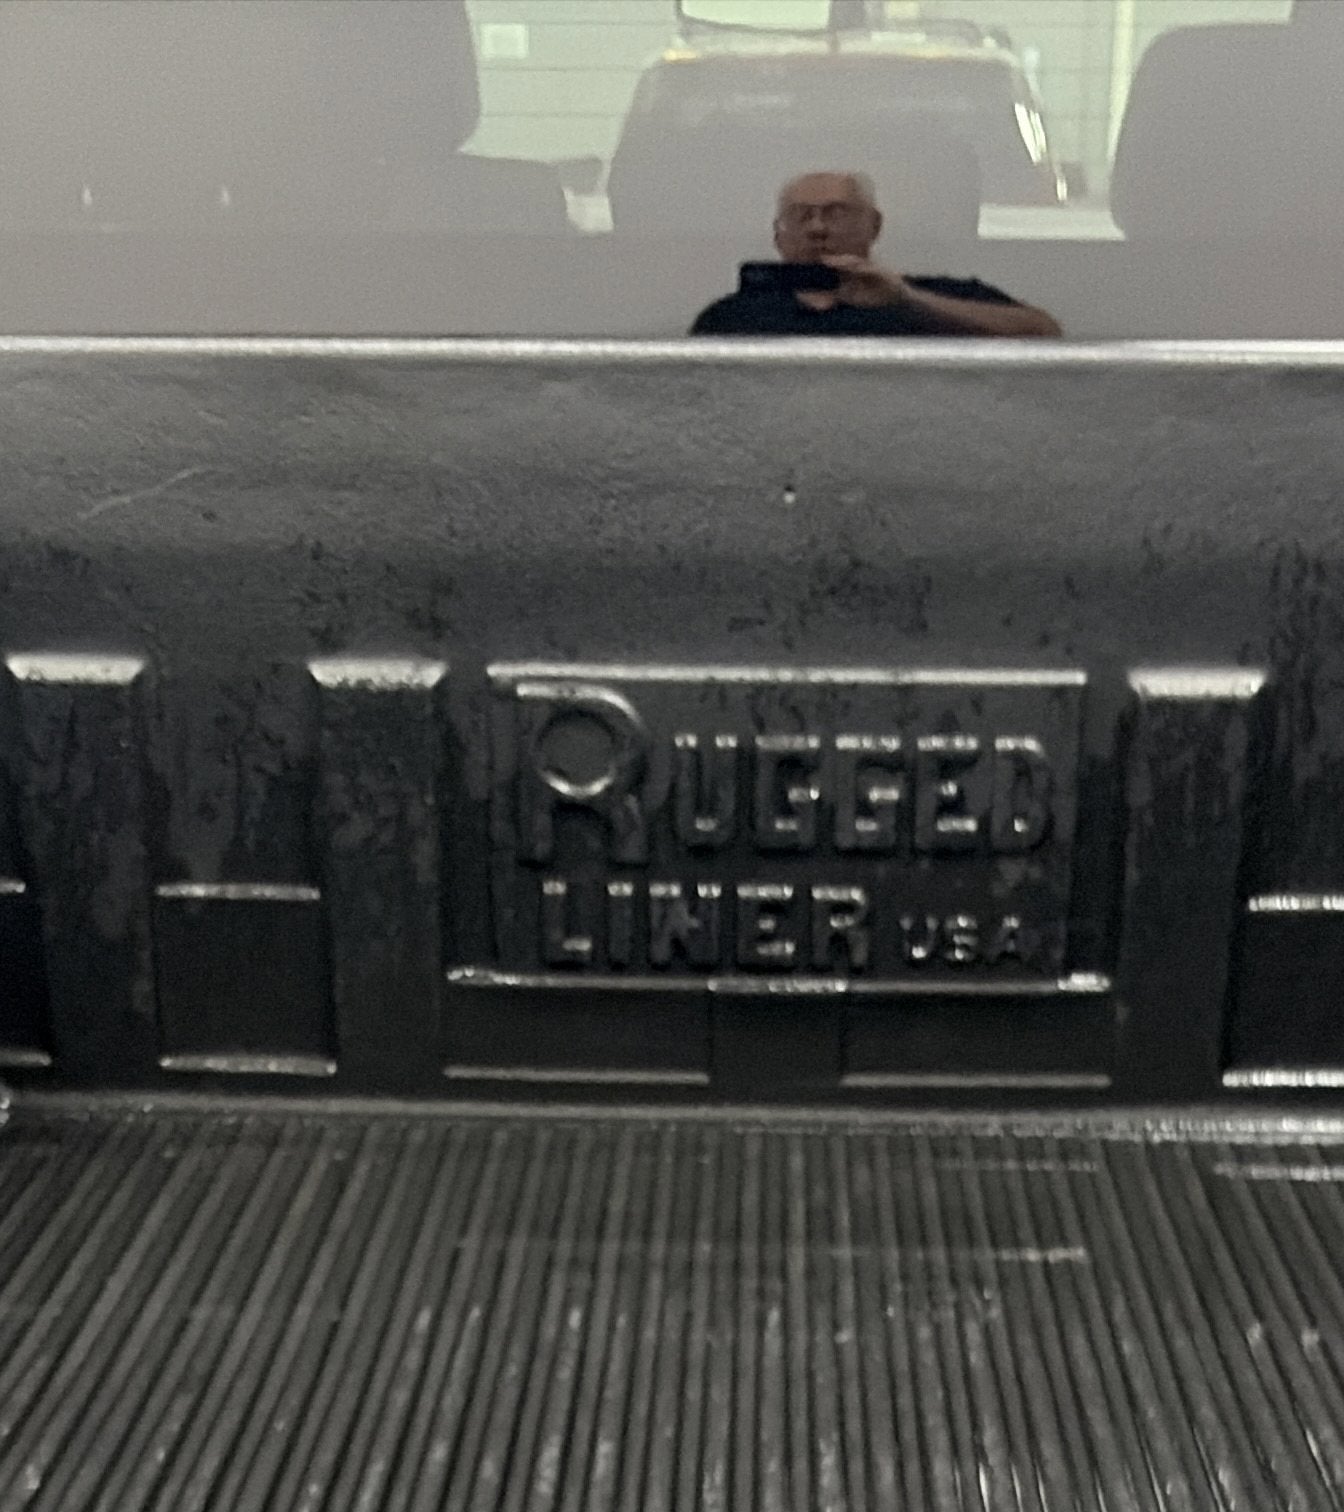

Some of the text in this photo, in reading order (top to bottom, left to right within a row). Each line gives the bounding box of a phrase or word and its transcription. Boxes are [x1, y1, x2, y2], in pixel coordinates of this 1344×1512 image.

[514, 682, 1048, 866] RUGGED
[538, 882, 1026, 969] LINER USA
